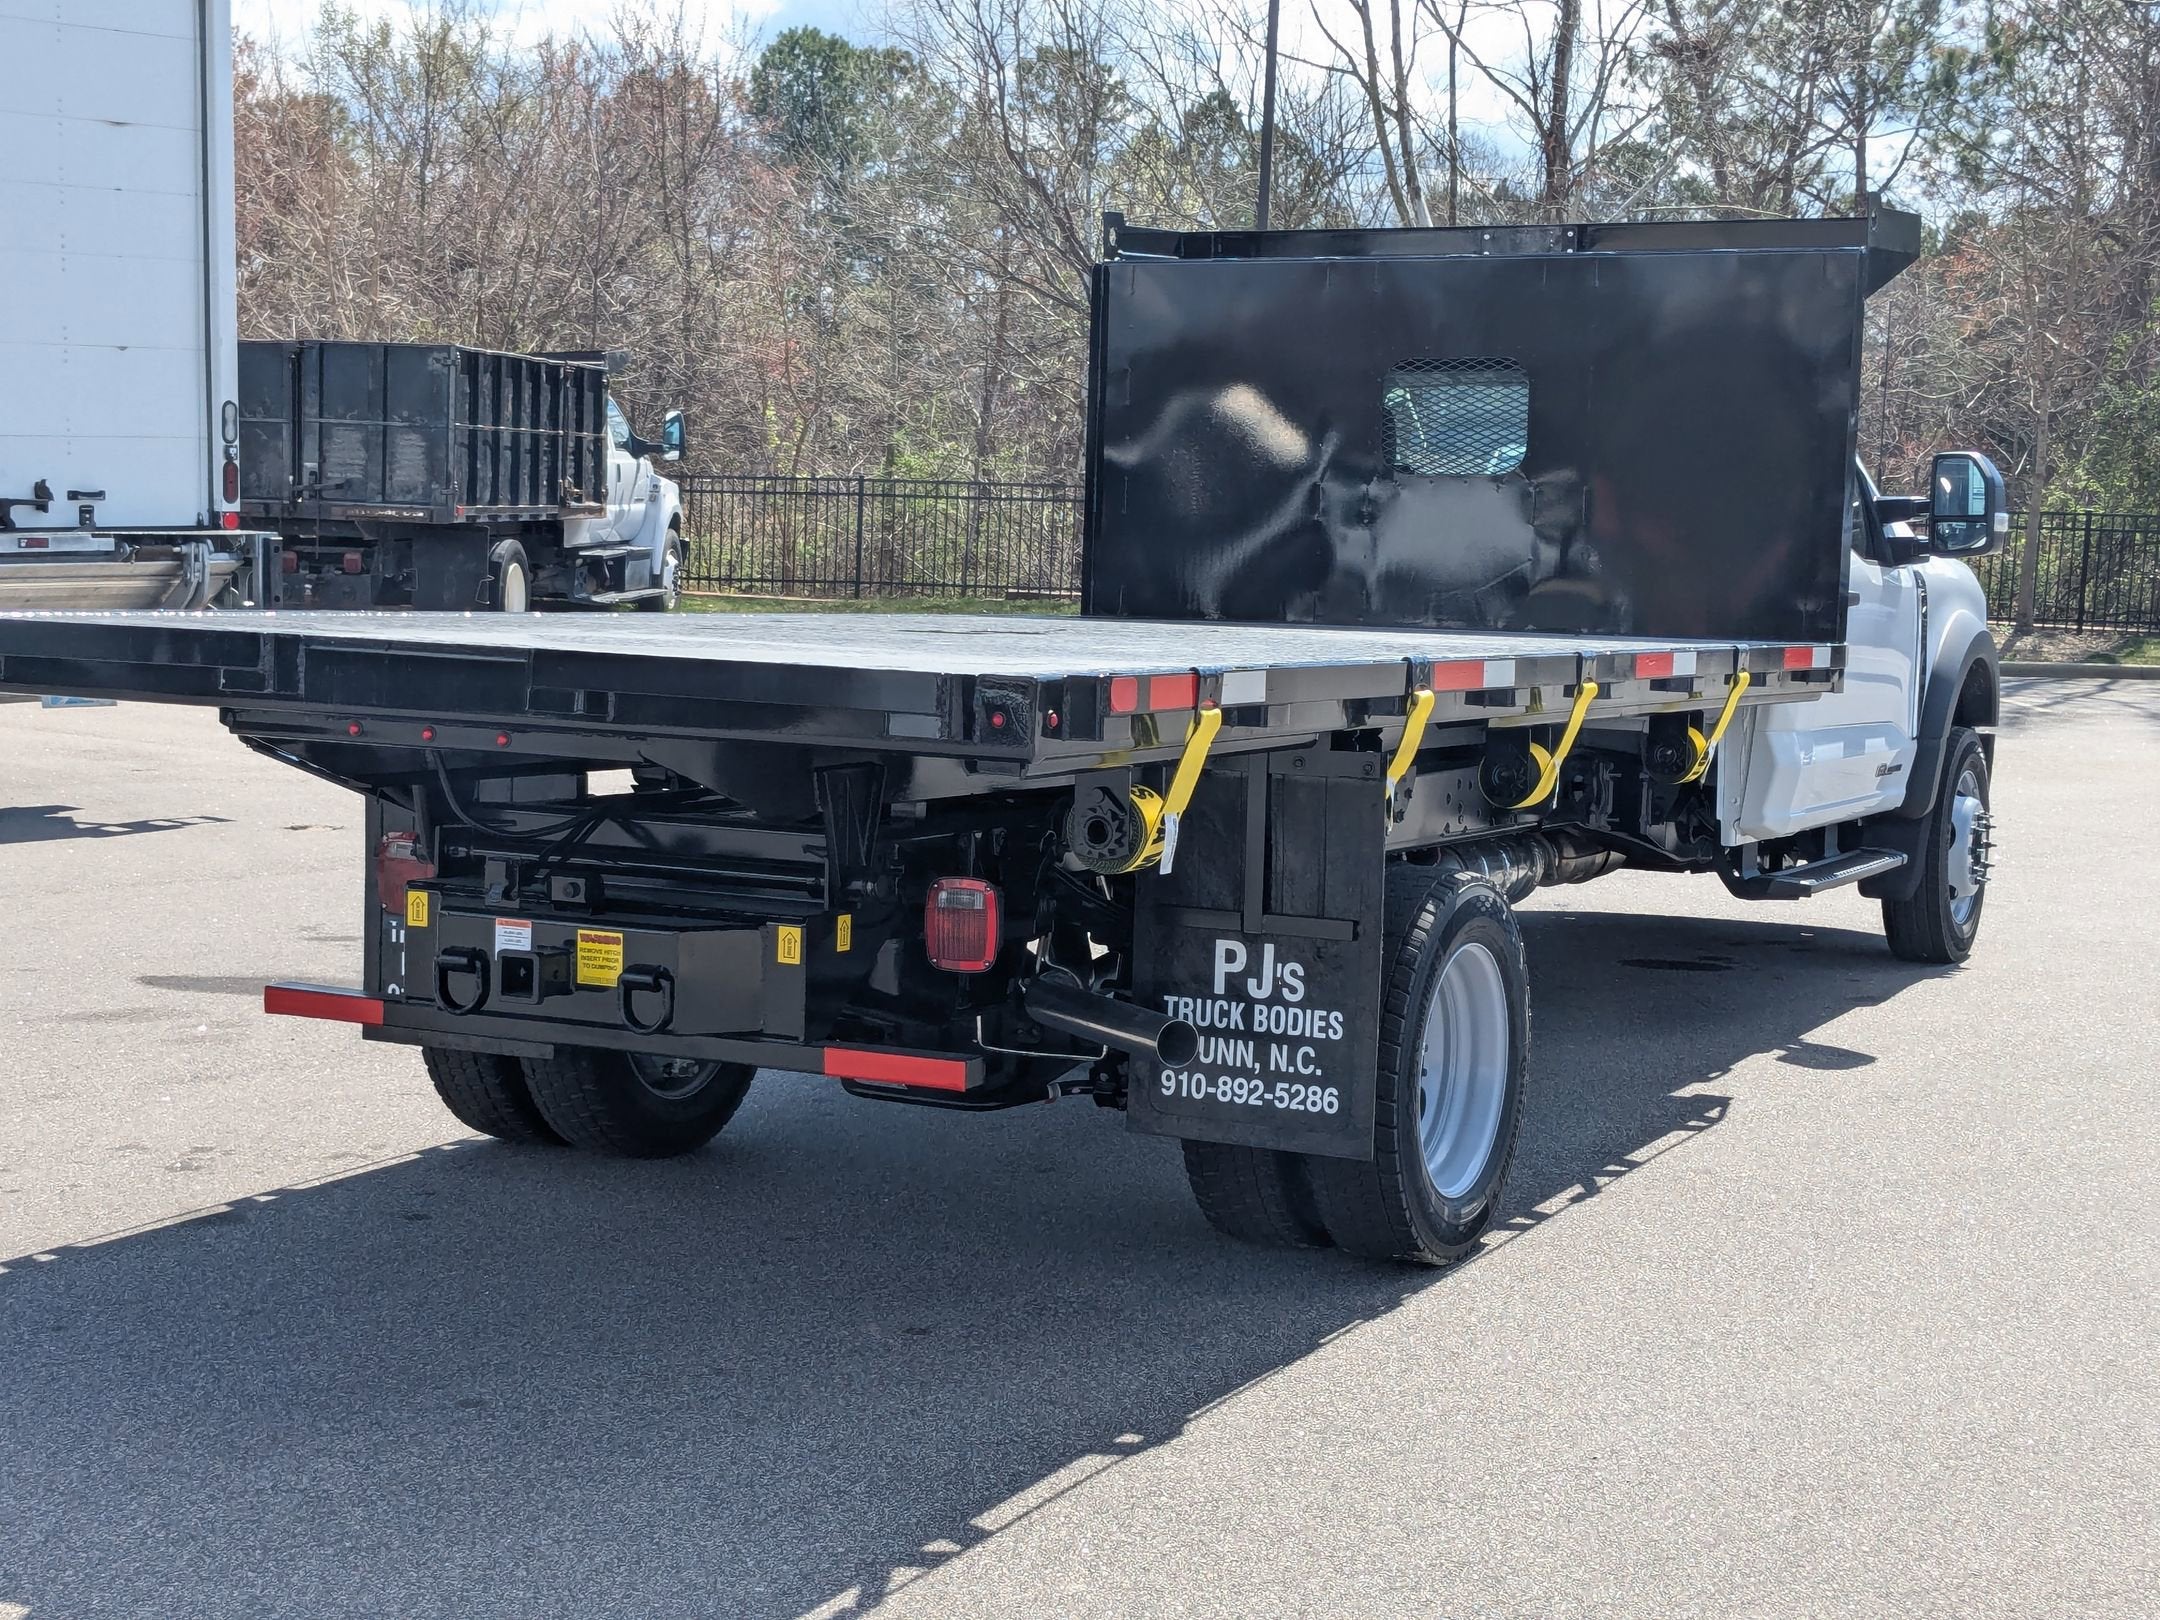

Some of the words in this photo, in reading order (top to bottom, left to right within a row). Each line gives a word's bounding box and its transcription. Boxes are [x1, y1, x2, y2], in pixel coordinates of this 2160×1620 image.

[1164, 995, 1245, 1031] TRUCK
[1253, 1004, 1344, 1040] BODIES
[1199, 1036, 1260, 1075] UNN,
[1270, 1044, 1322, 1076] N.C.
[1161, 1070, 1339, 1115] 910-892-5286
